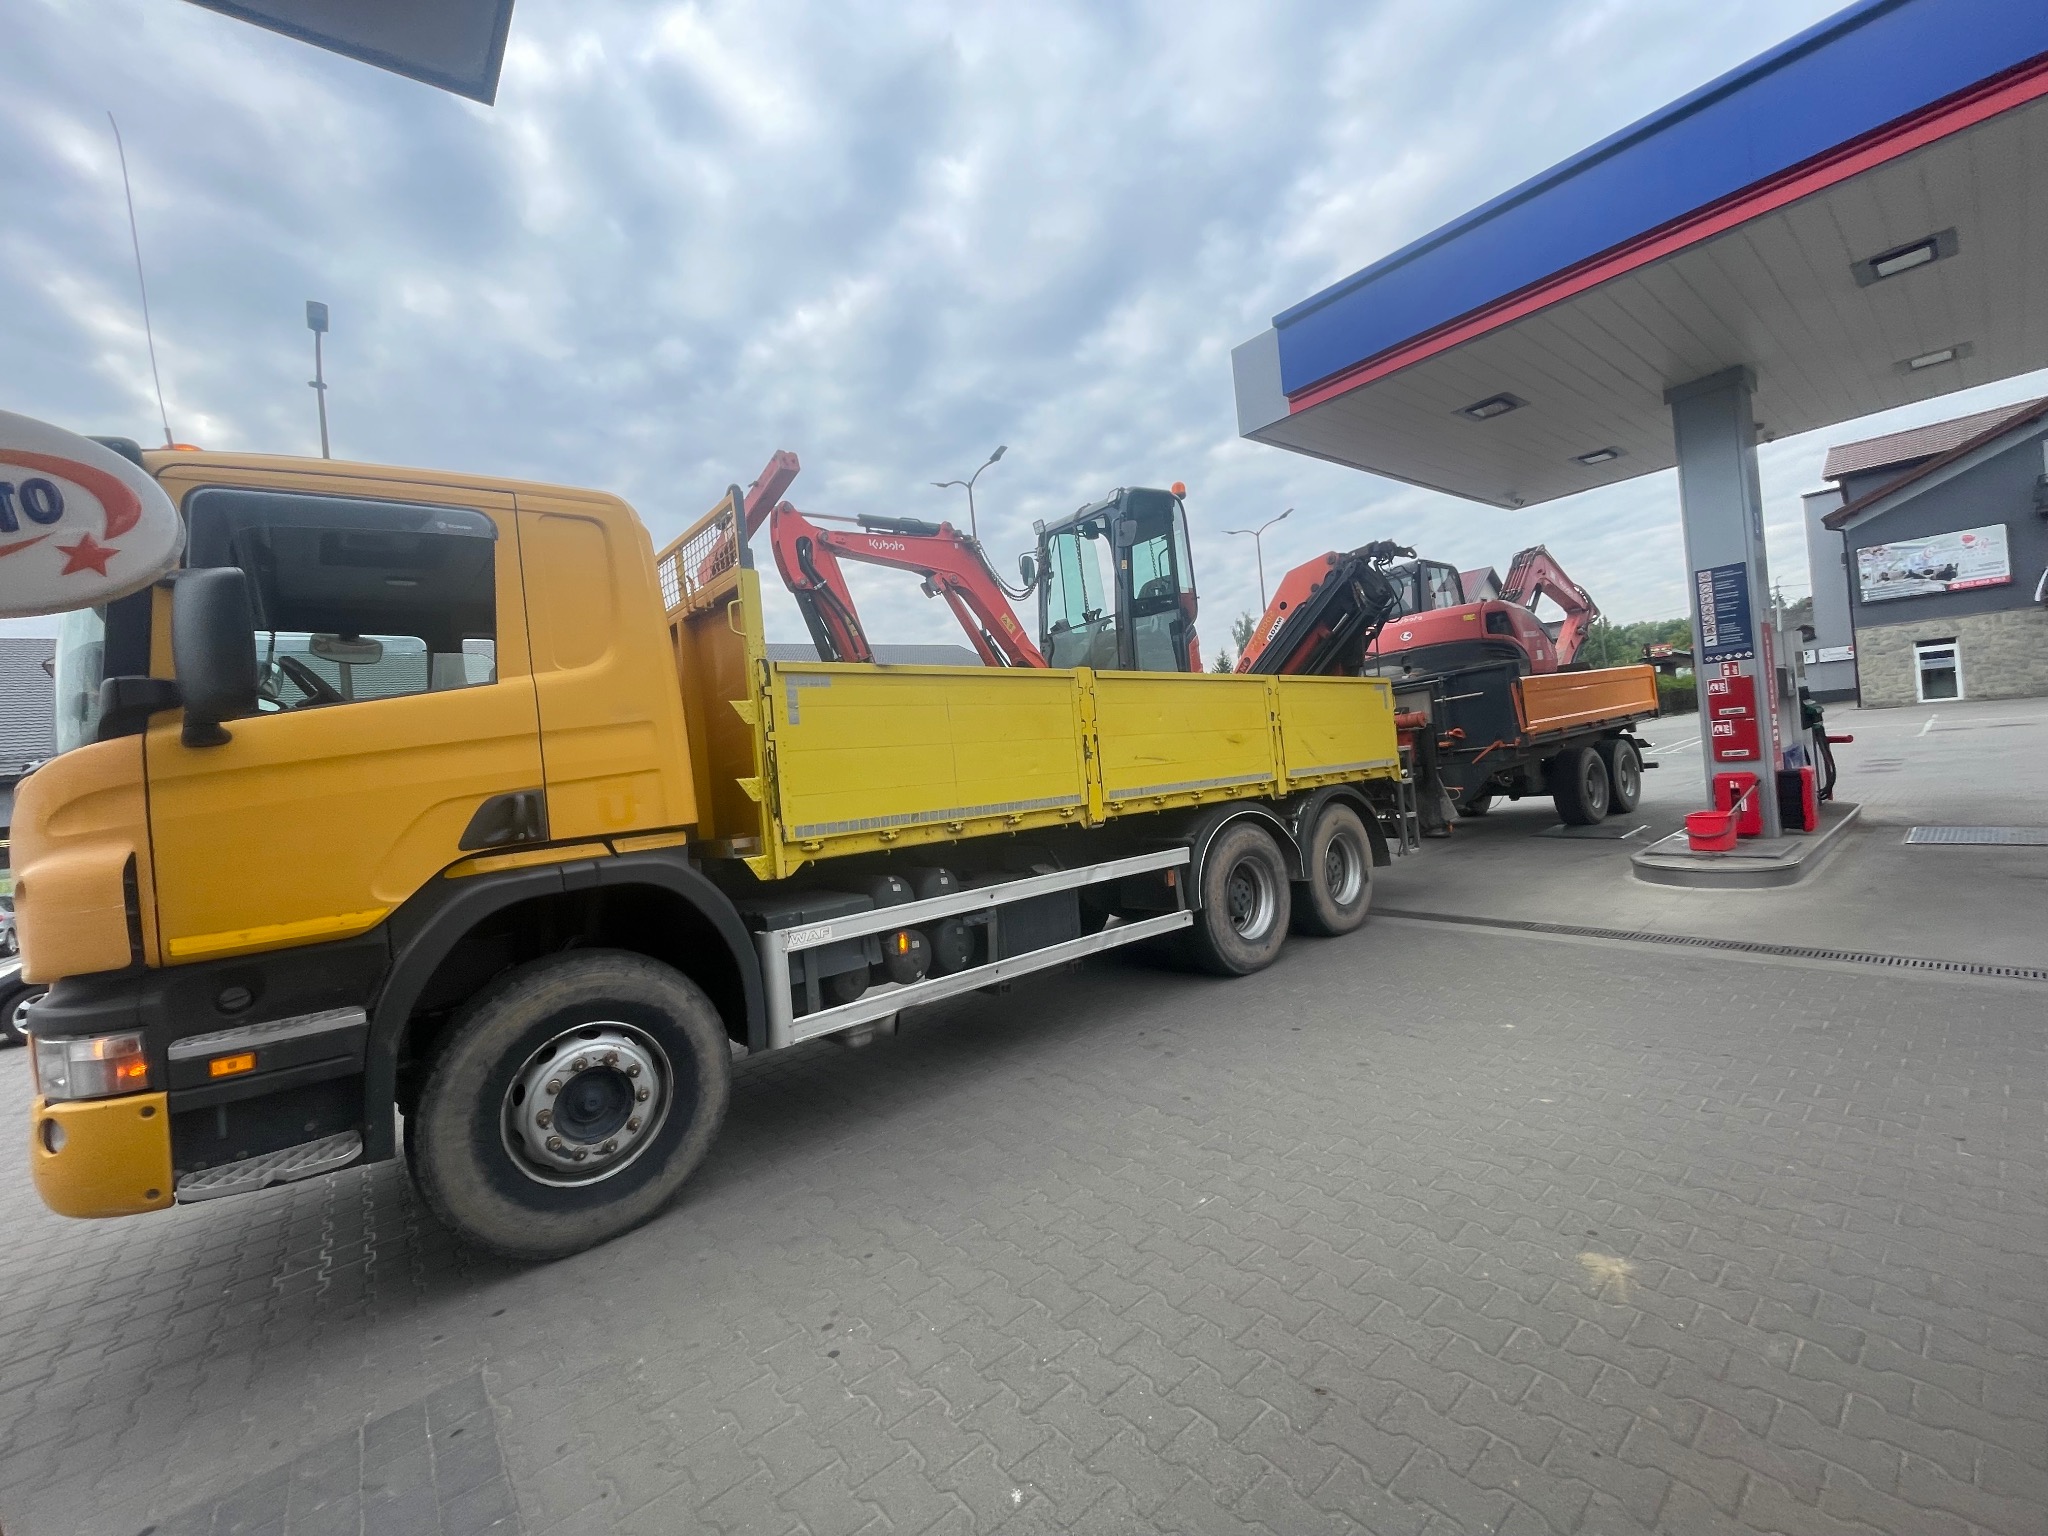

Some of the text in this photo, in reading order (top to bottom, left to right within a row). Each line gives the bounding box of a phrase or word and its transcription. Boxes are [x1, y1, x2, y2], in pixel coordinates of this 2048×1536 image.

[868, 538, 905, 551] Kubota
[1267, 616, 1283, 641] ADAM
[790, 926, 830, 945] WAF
